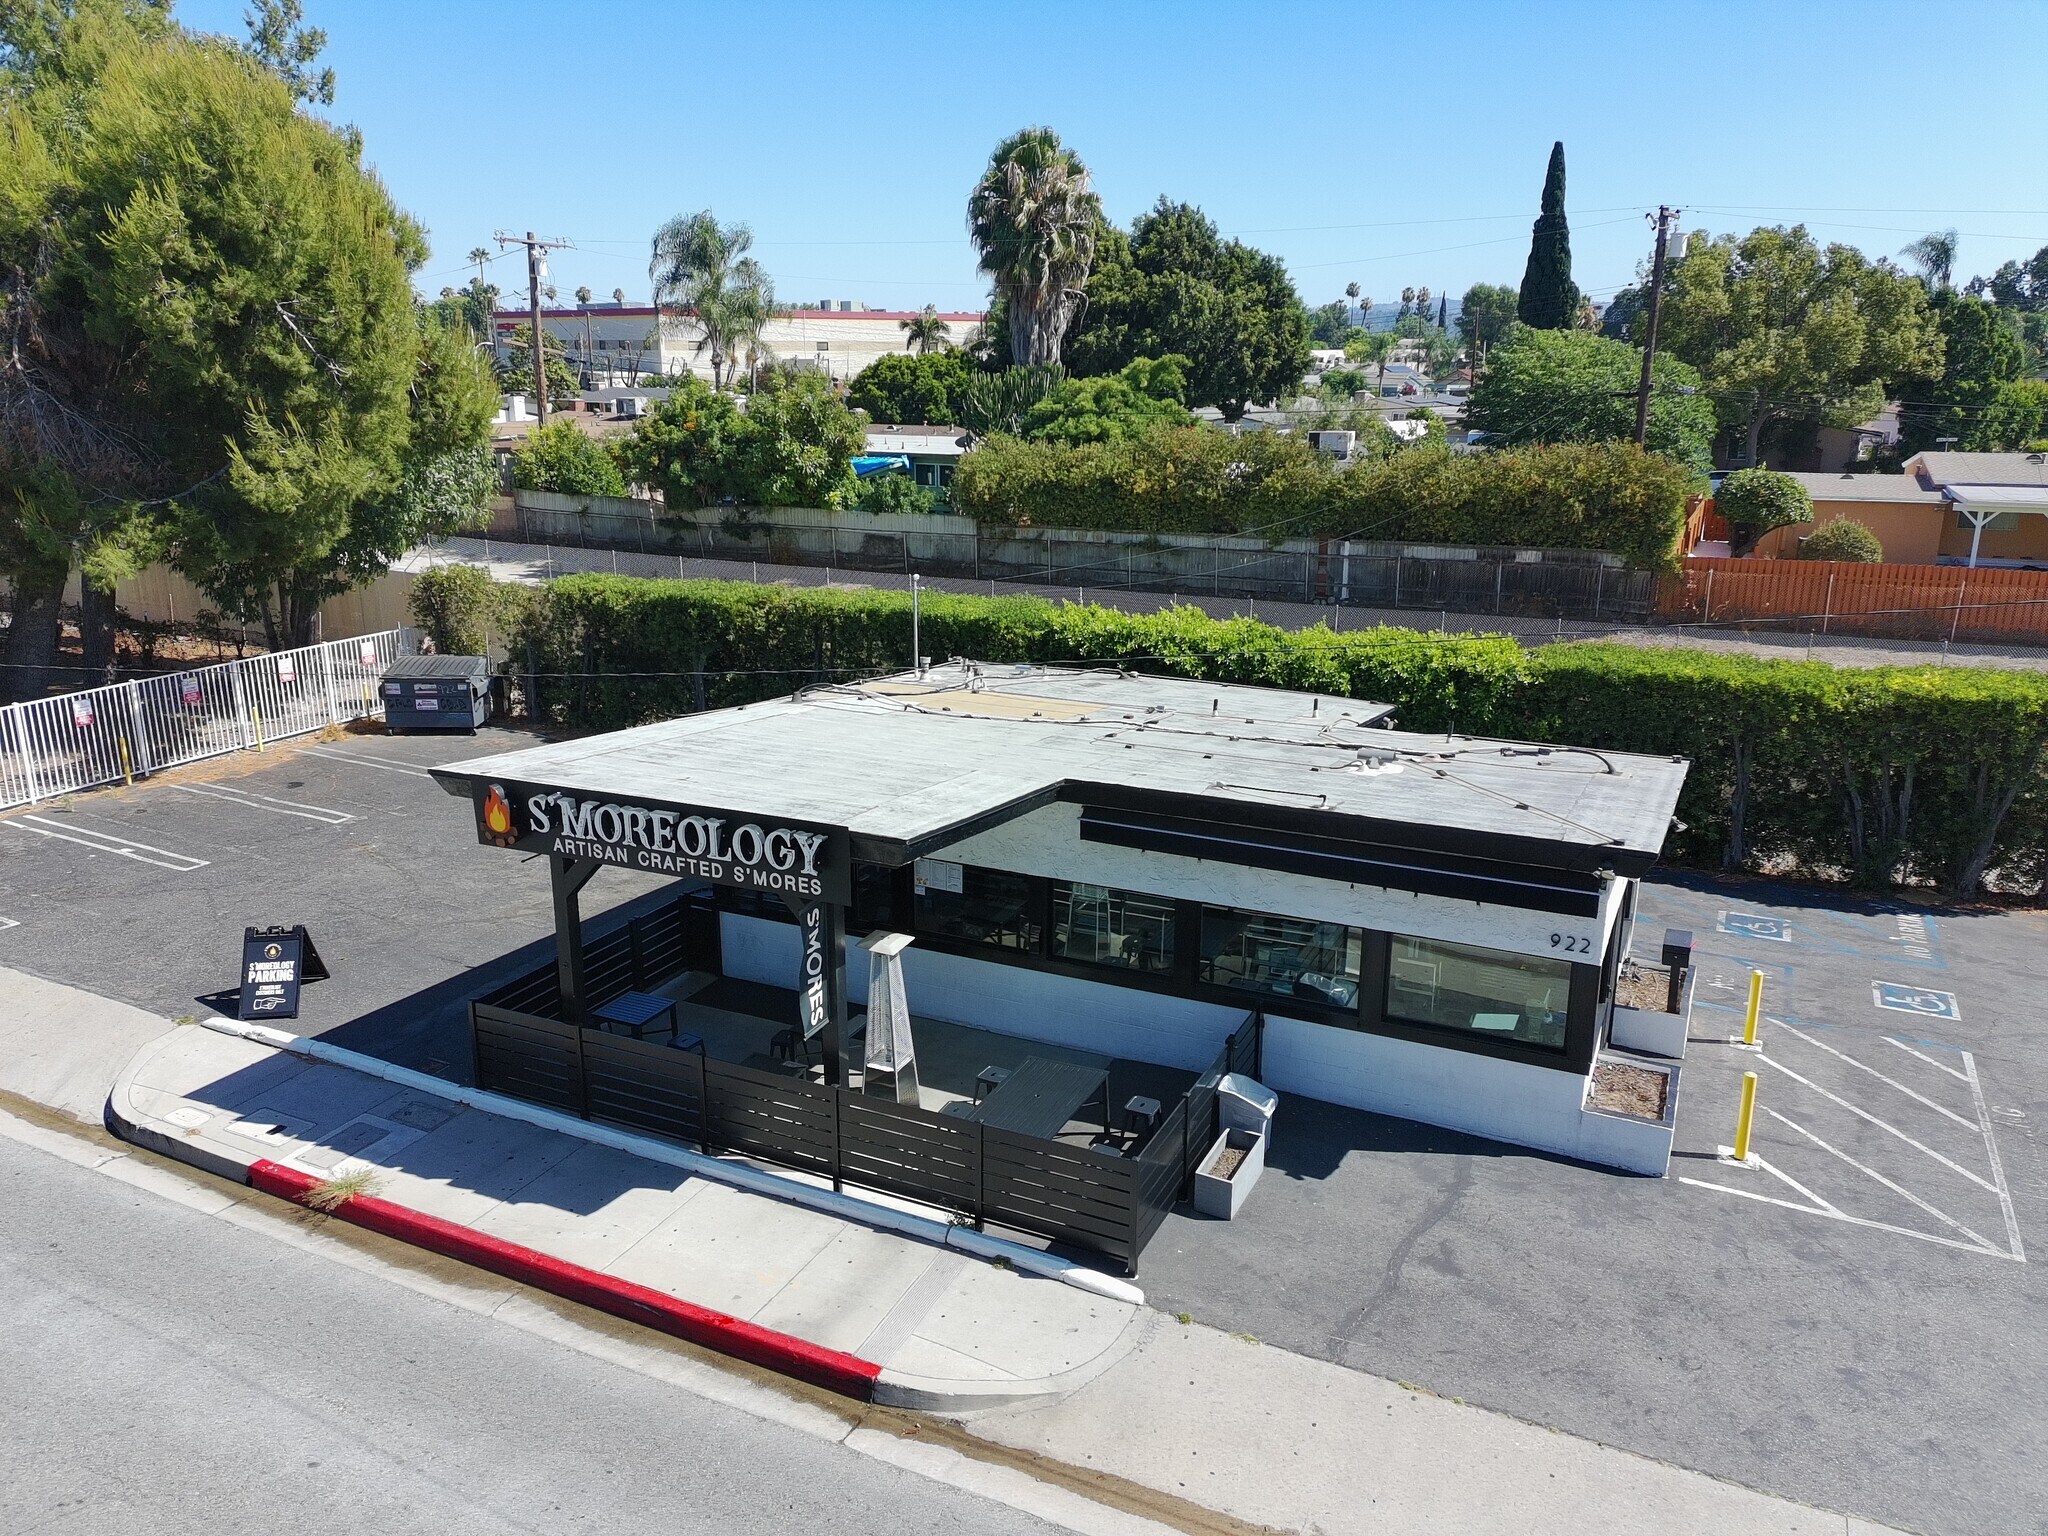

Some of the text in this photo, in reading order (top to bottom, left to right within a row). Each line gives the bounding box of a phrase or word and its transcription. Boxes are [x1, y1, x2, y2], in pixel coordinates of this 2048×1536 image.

[528, 792, 828, 877] S'MOREOLOGY
[553, 838, 822, 897] ARTISAN CRAFTED S'MORES
[806, 907, 824, 1026] S'MORES
[1550, 933, 1591, 954] 922
[248, 969, 294, 983] PARKING
